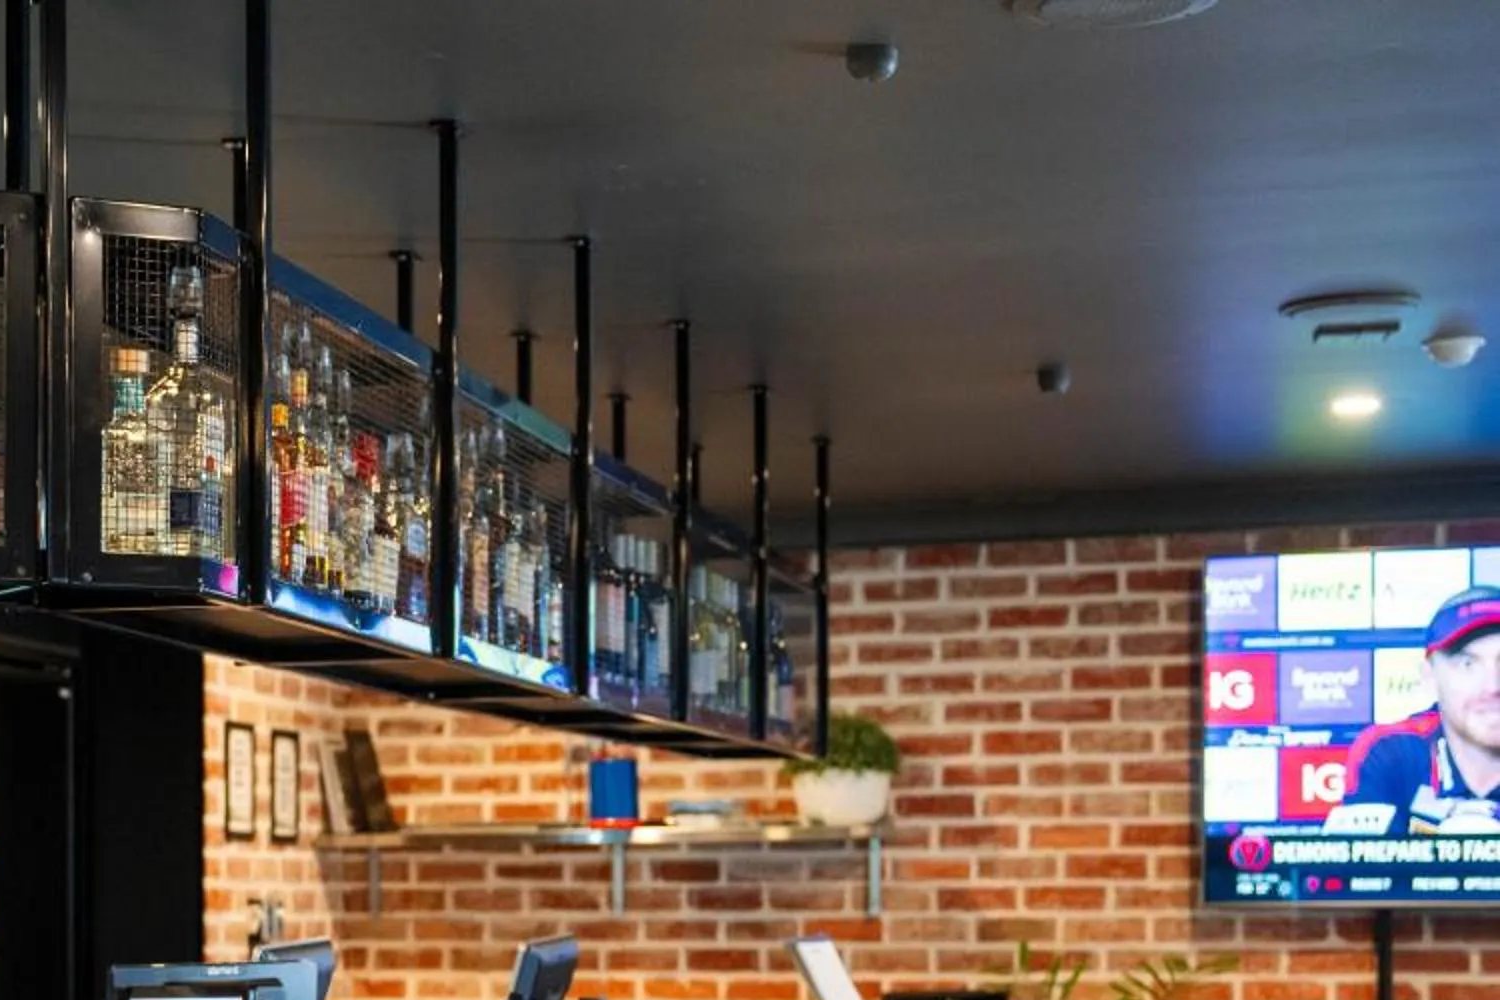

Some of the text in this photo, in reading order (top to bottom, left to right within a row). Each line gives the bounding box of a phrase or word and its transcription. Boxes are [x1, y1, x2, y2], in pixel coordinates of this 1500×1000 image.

[1208, 670, 1254, 711] IG
[1273, 839, 1500, 863] DEMONS PREPARE TO FAC
